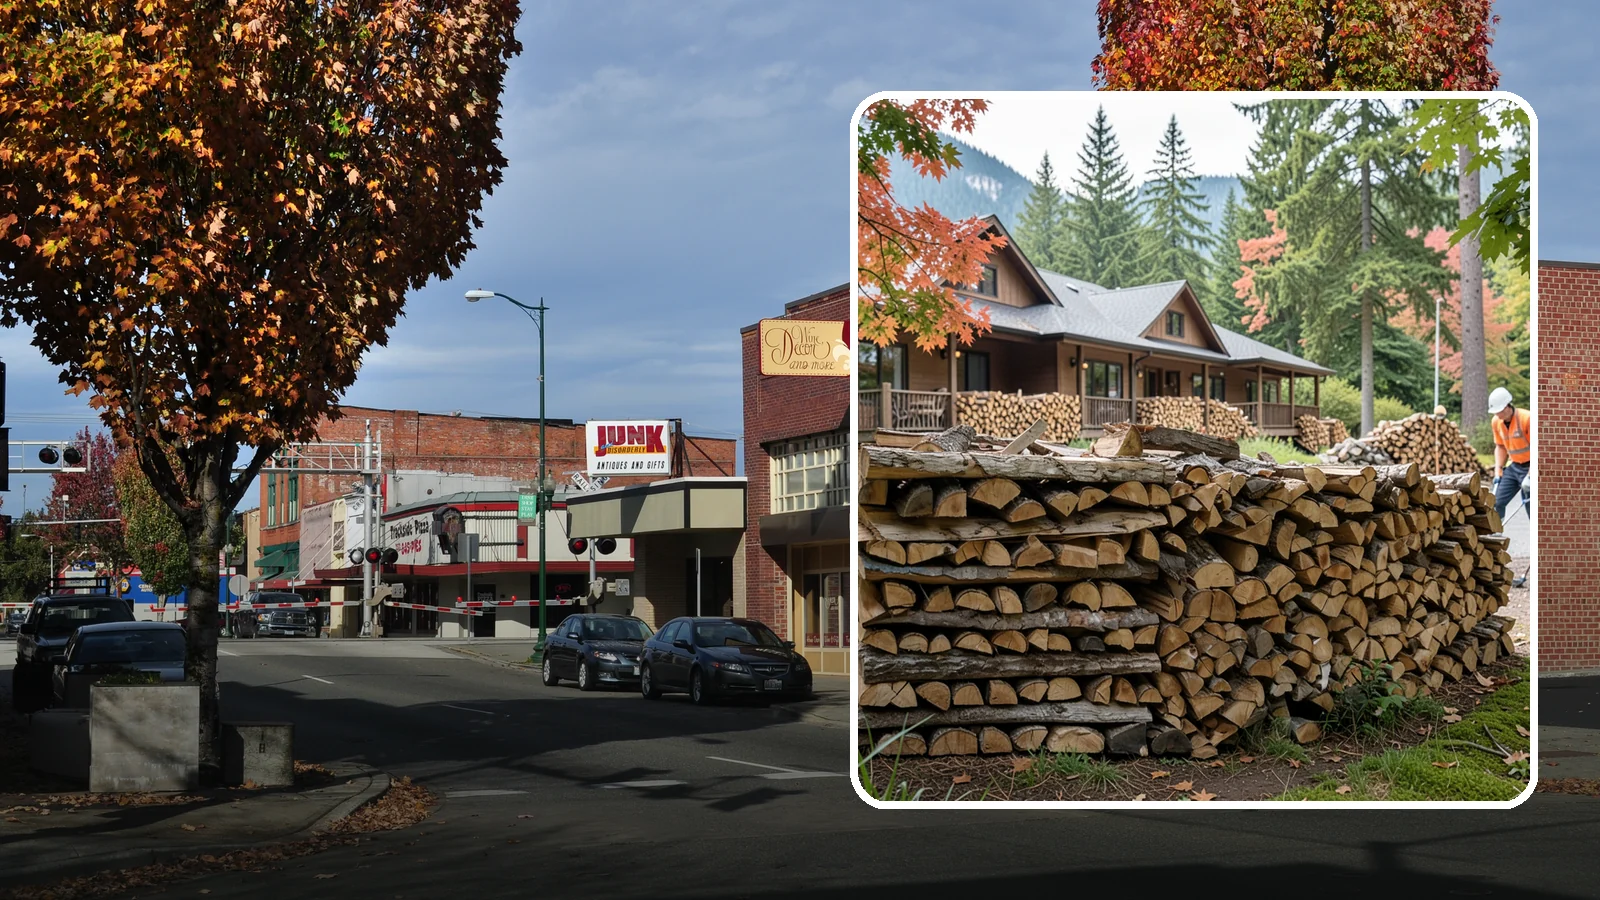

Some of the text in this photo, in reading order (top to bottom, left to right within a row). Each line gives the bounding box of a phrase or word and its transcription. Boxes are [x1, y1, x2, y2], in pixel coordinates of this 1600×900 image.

[595, 425, 665, 457] JUNK
[597, 460, 665, 470] ANTIQUES AND GIFTS
[415, 520, 429, 534] Pizza
